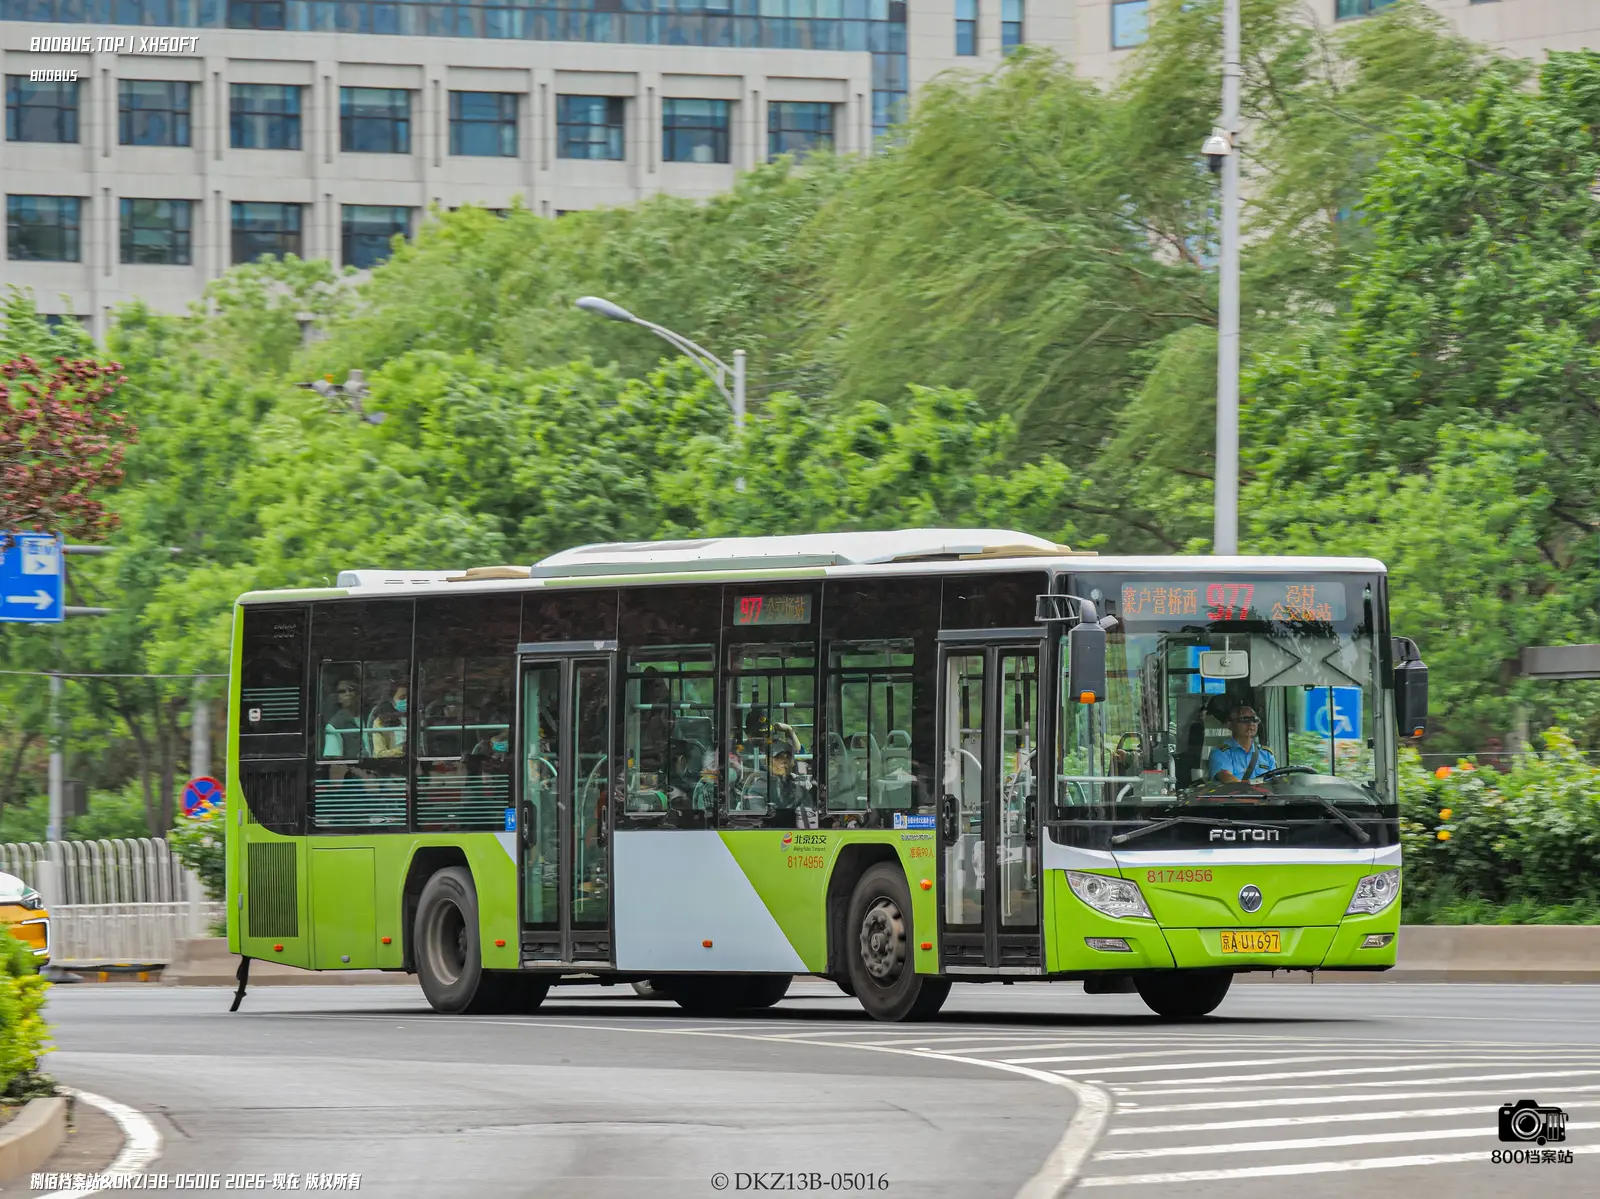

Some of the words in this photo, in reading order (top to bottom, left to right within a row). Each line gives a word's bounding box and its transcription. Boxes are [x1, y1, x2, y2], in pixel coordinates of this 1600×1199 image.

[1122, 586, 1198, 616] 菜户营桥西
[1206, 583, 1255, 621] 977
[1286, 584, 1317, 604] 冯村
[740, 596, 763, 623] 977
[1271, 602, 1333, 622] 公交场站
[794, 834, 828, 845] 北京公交
[1209, 828, 1279, 842] FOTON
[909, 846, 935, 858] 准乘90人
[787, 855, 824, 869] 8174956
[1147, 869, 1213, 883] 8174956
